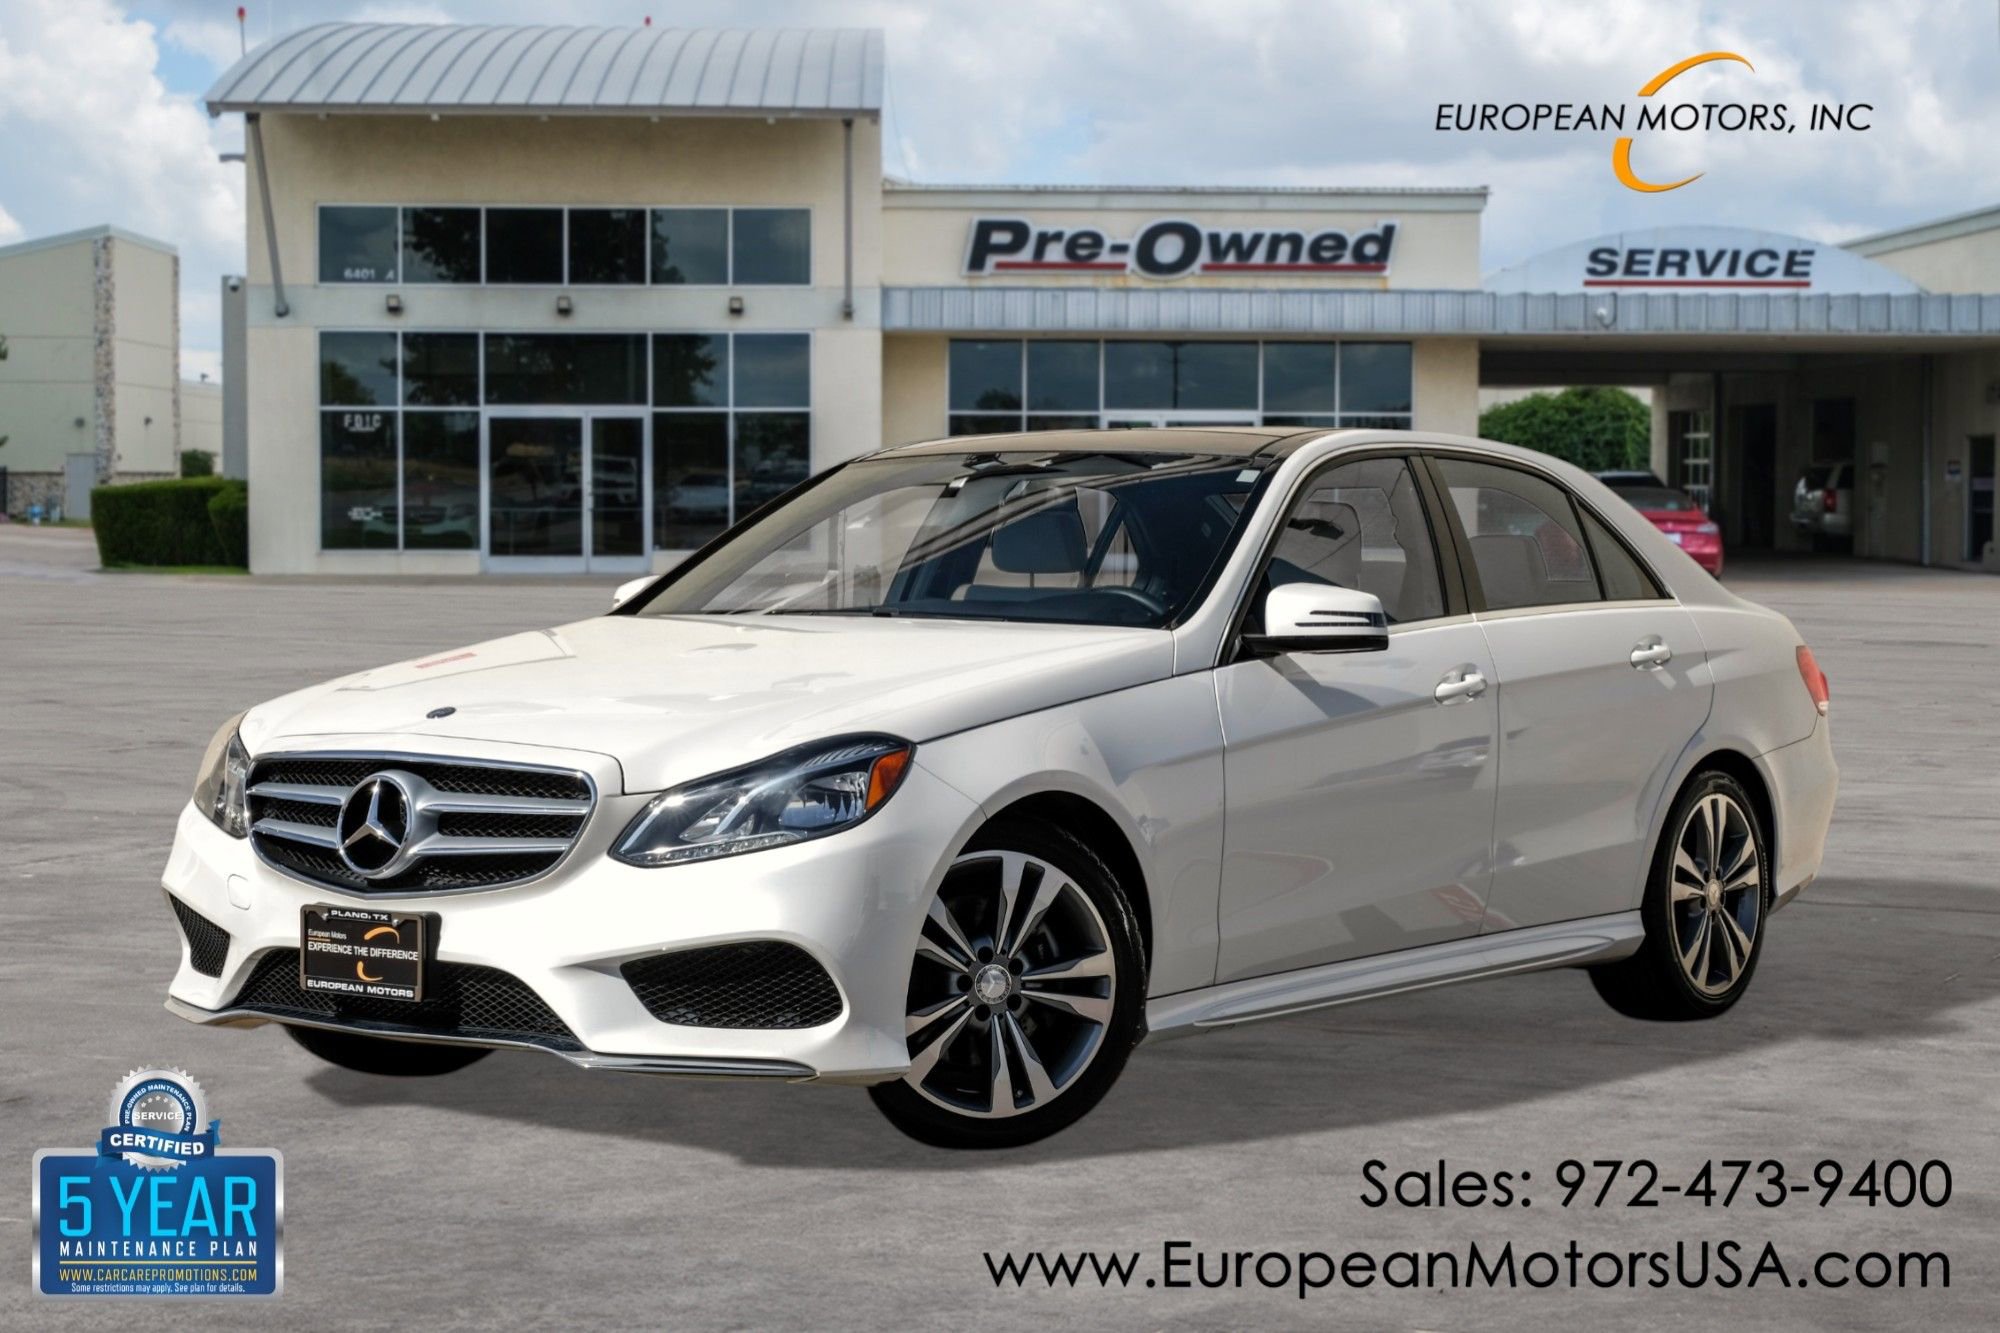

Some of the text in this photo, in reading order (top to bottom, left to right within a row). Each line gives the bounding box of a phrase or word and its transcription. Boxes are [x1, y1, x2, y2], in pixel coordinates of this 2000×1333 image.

[967, 219, 1397, 276] Pre-Owned
[1586, 247, 1815, 277] SERVICE
[344, 267, 375, 280] 6401
[331, 910, 388, 921] PLANO, TX
[308, 929, 347, 940] European Motors
[308, 942, 419, 961] EXPERIENCE THE DIFFERENCE
[307, 980, 414, 998] EUROPEAN MOTORS
